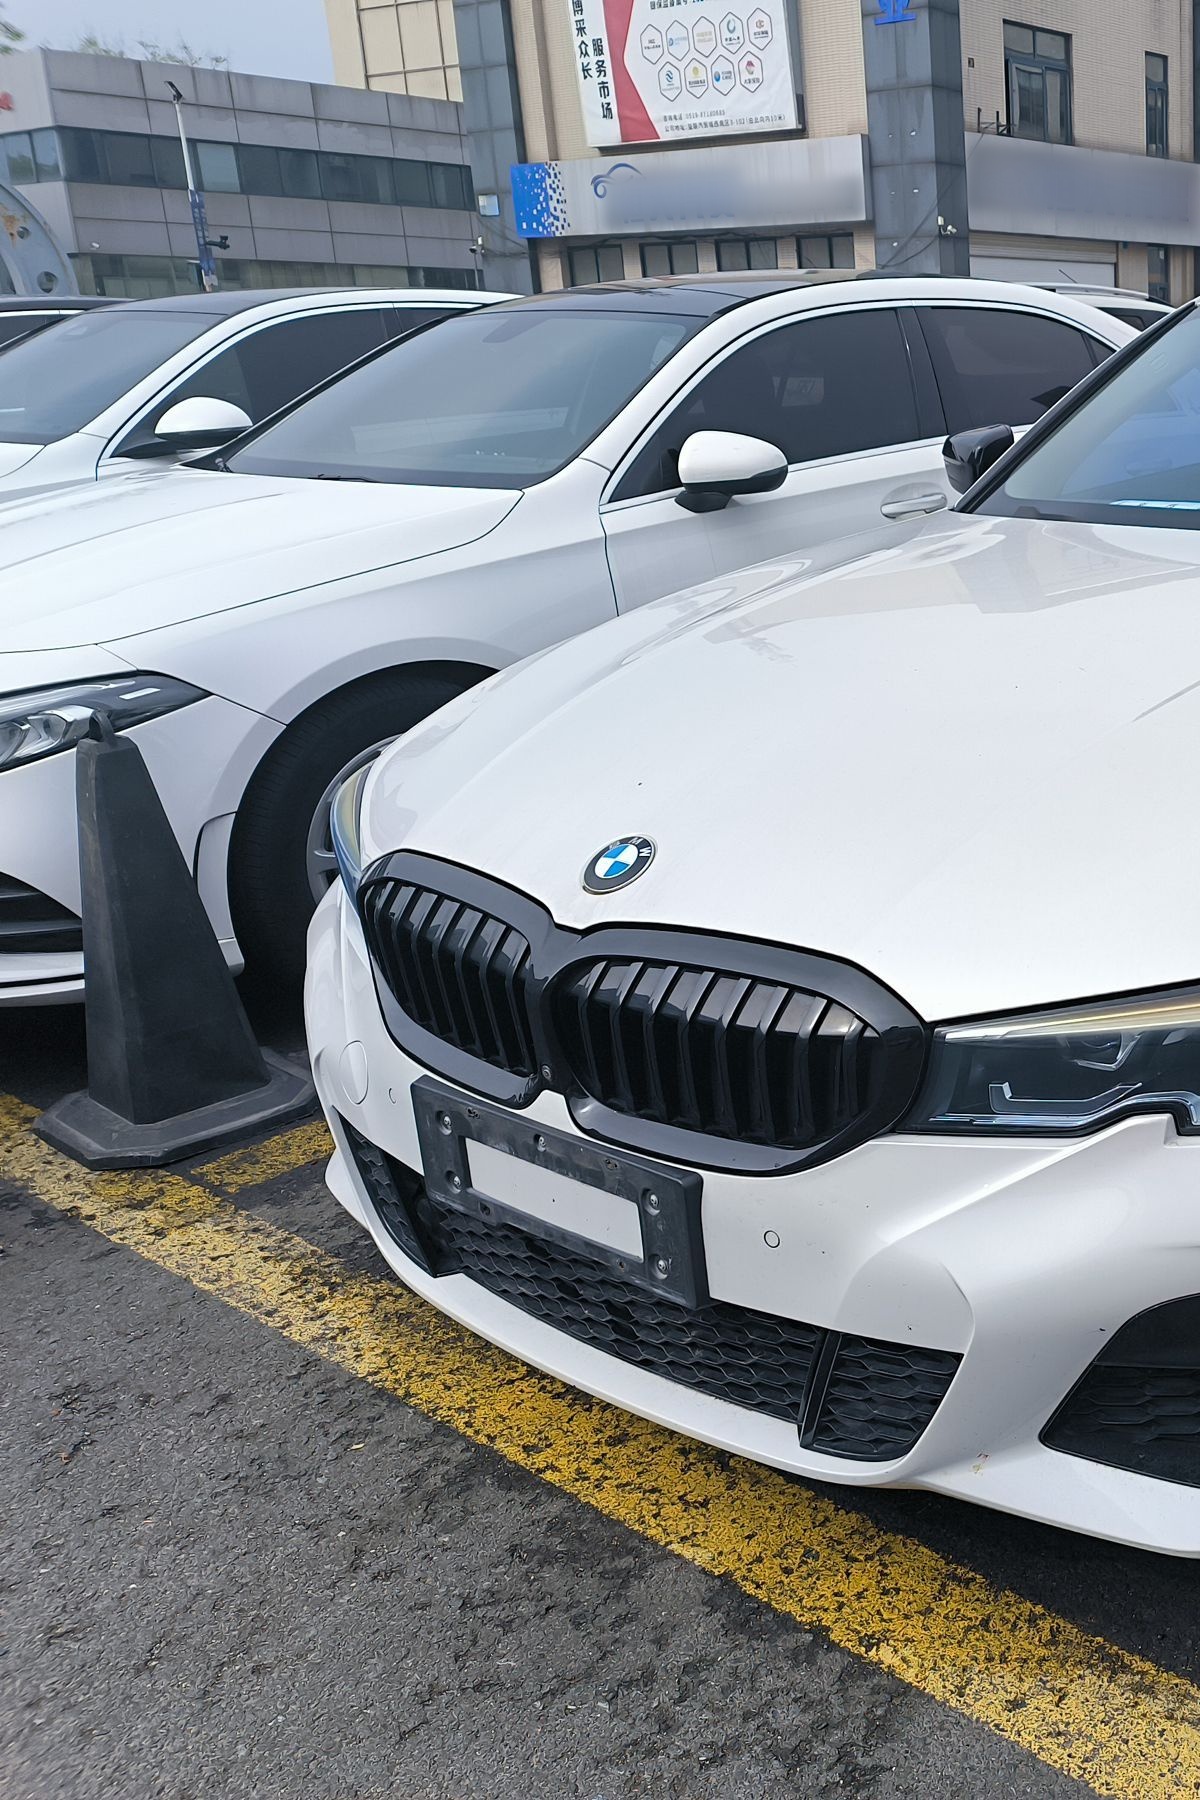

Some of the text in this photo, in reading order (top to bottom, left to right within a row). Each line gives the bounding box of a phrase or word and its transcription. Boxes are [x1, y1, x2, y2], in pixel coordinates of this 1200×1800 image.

[571, 0, 593, 80] 博采众长
[591, 38, 614, 120] 服务市场
